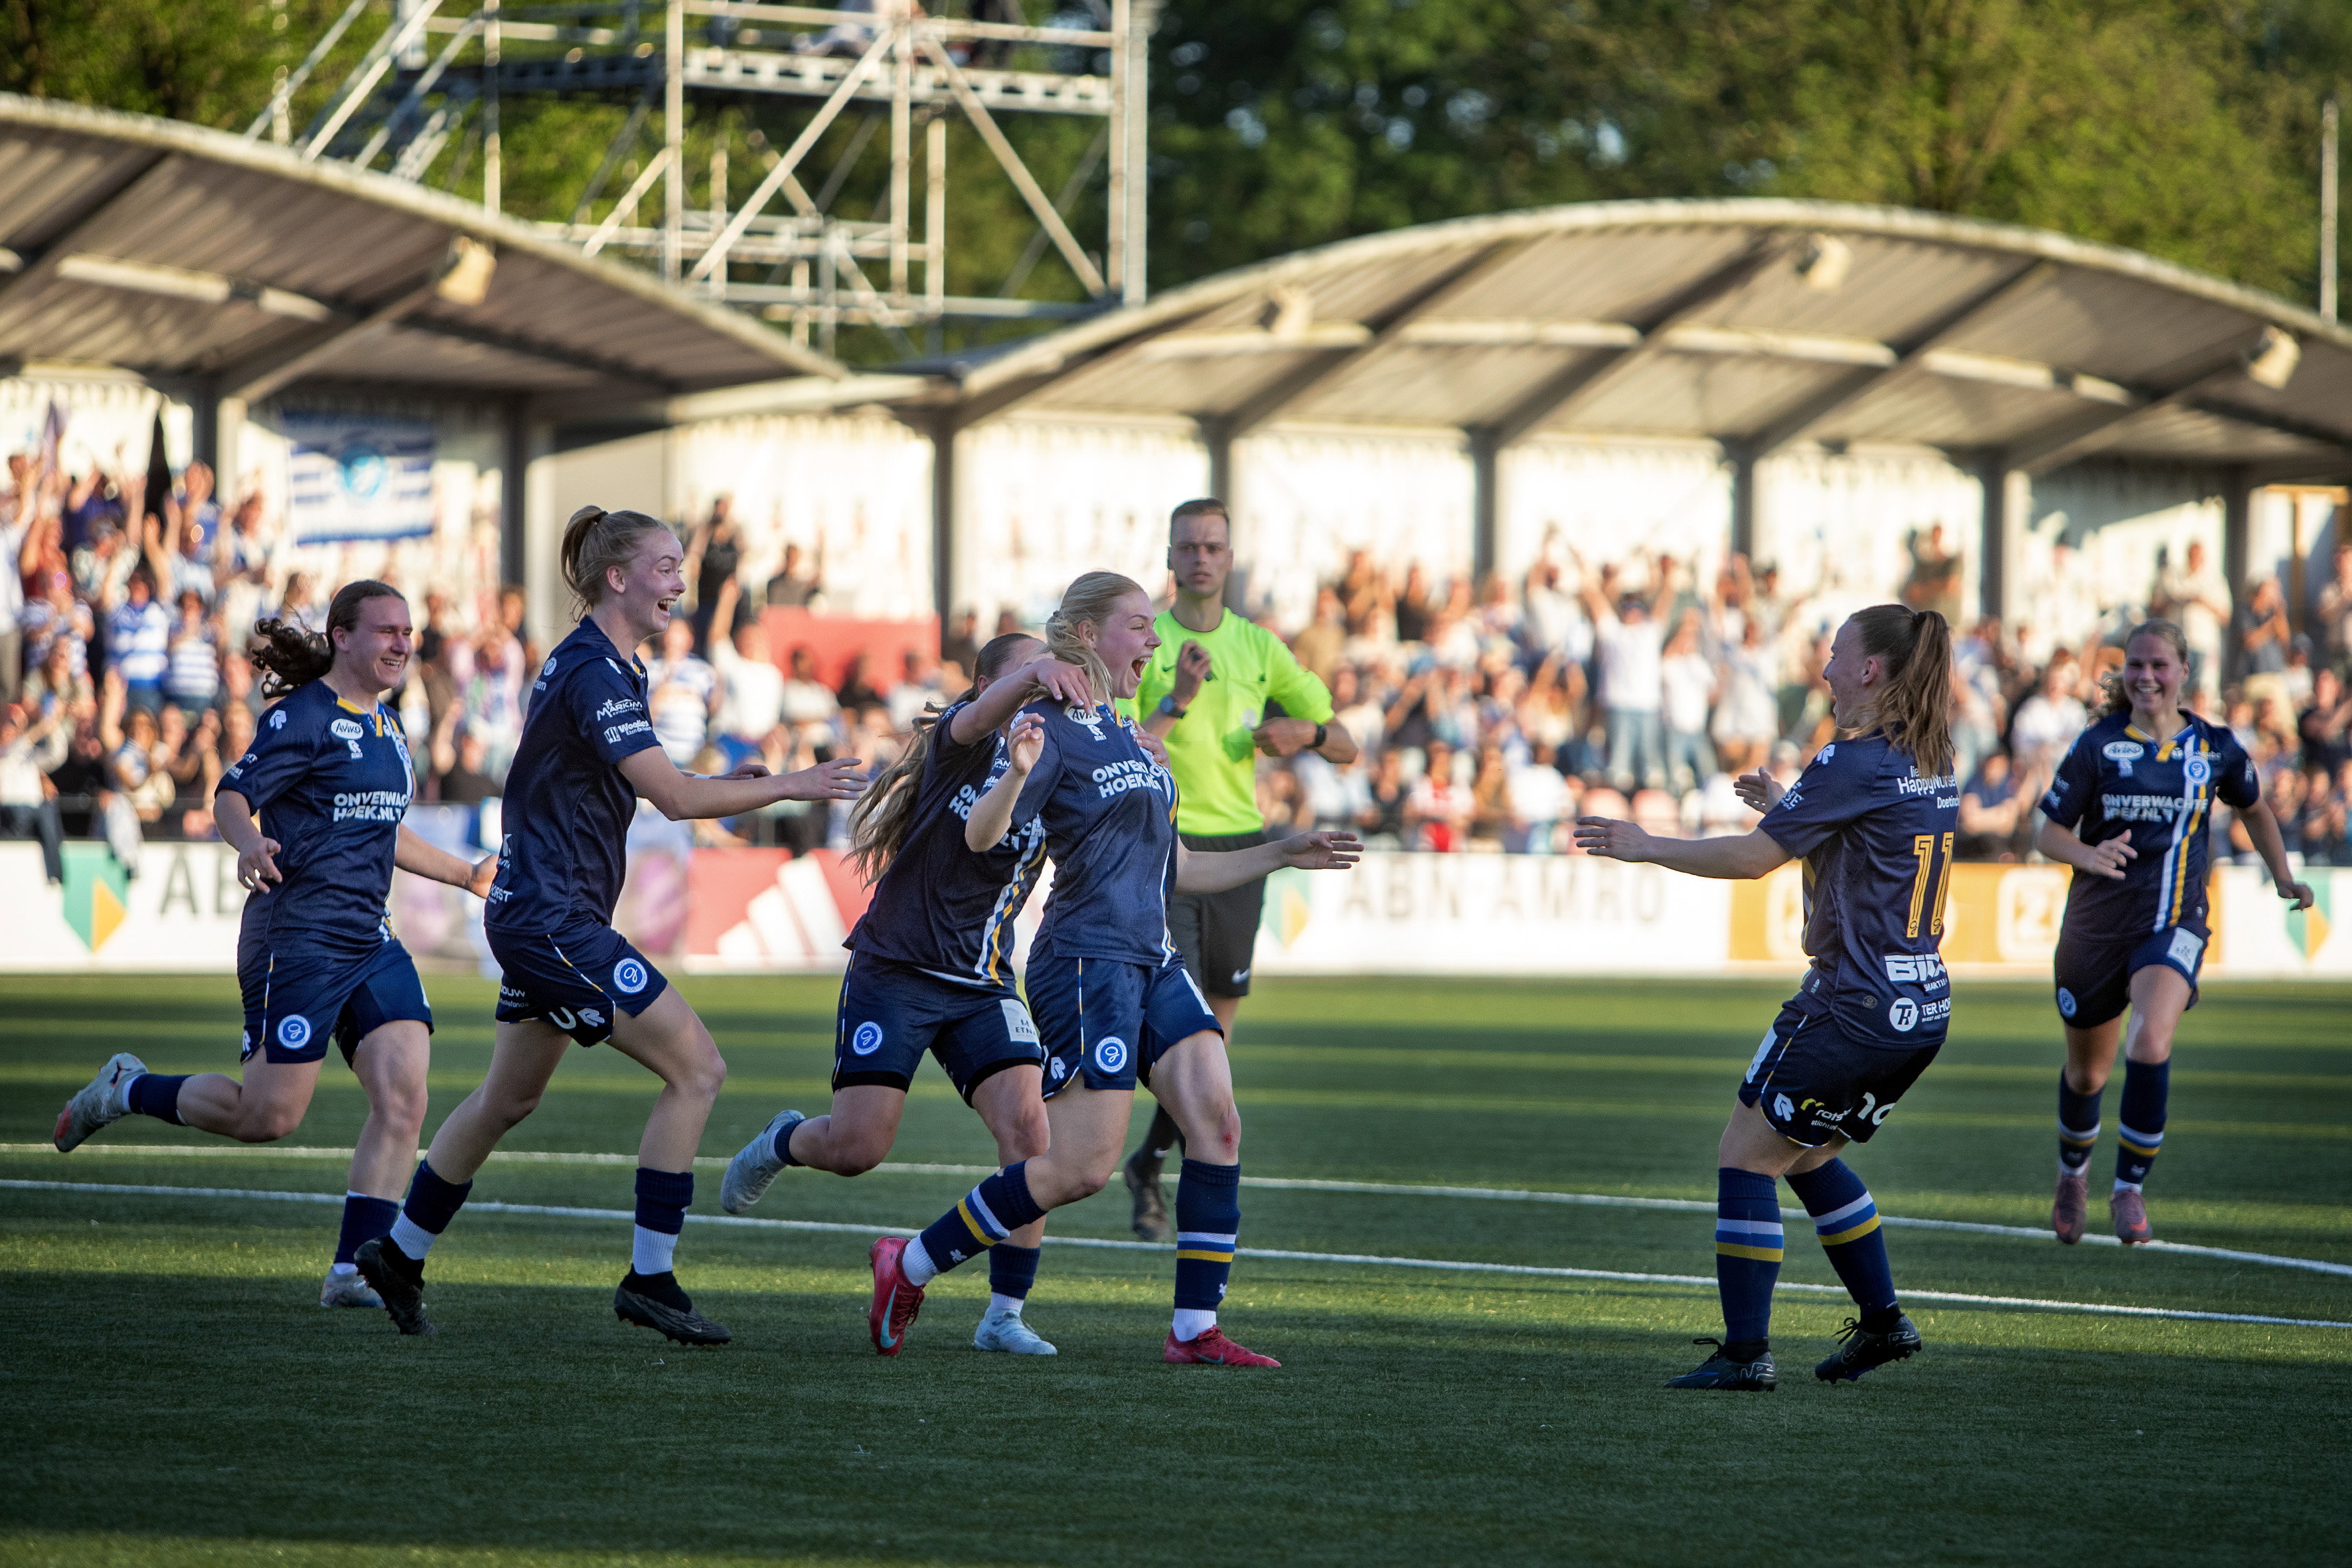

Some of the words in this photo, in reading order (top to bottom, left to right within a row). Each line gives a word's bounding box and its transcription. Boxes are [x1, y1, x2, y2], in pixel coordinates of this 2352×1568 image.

[333, 805, 396, 822] HOEK.NL
[159, 844, 246, 915] AB
[1907, 832, 1954, 938] 11
[1921, 1004, 1938, 1016] TER
